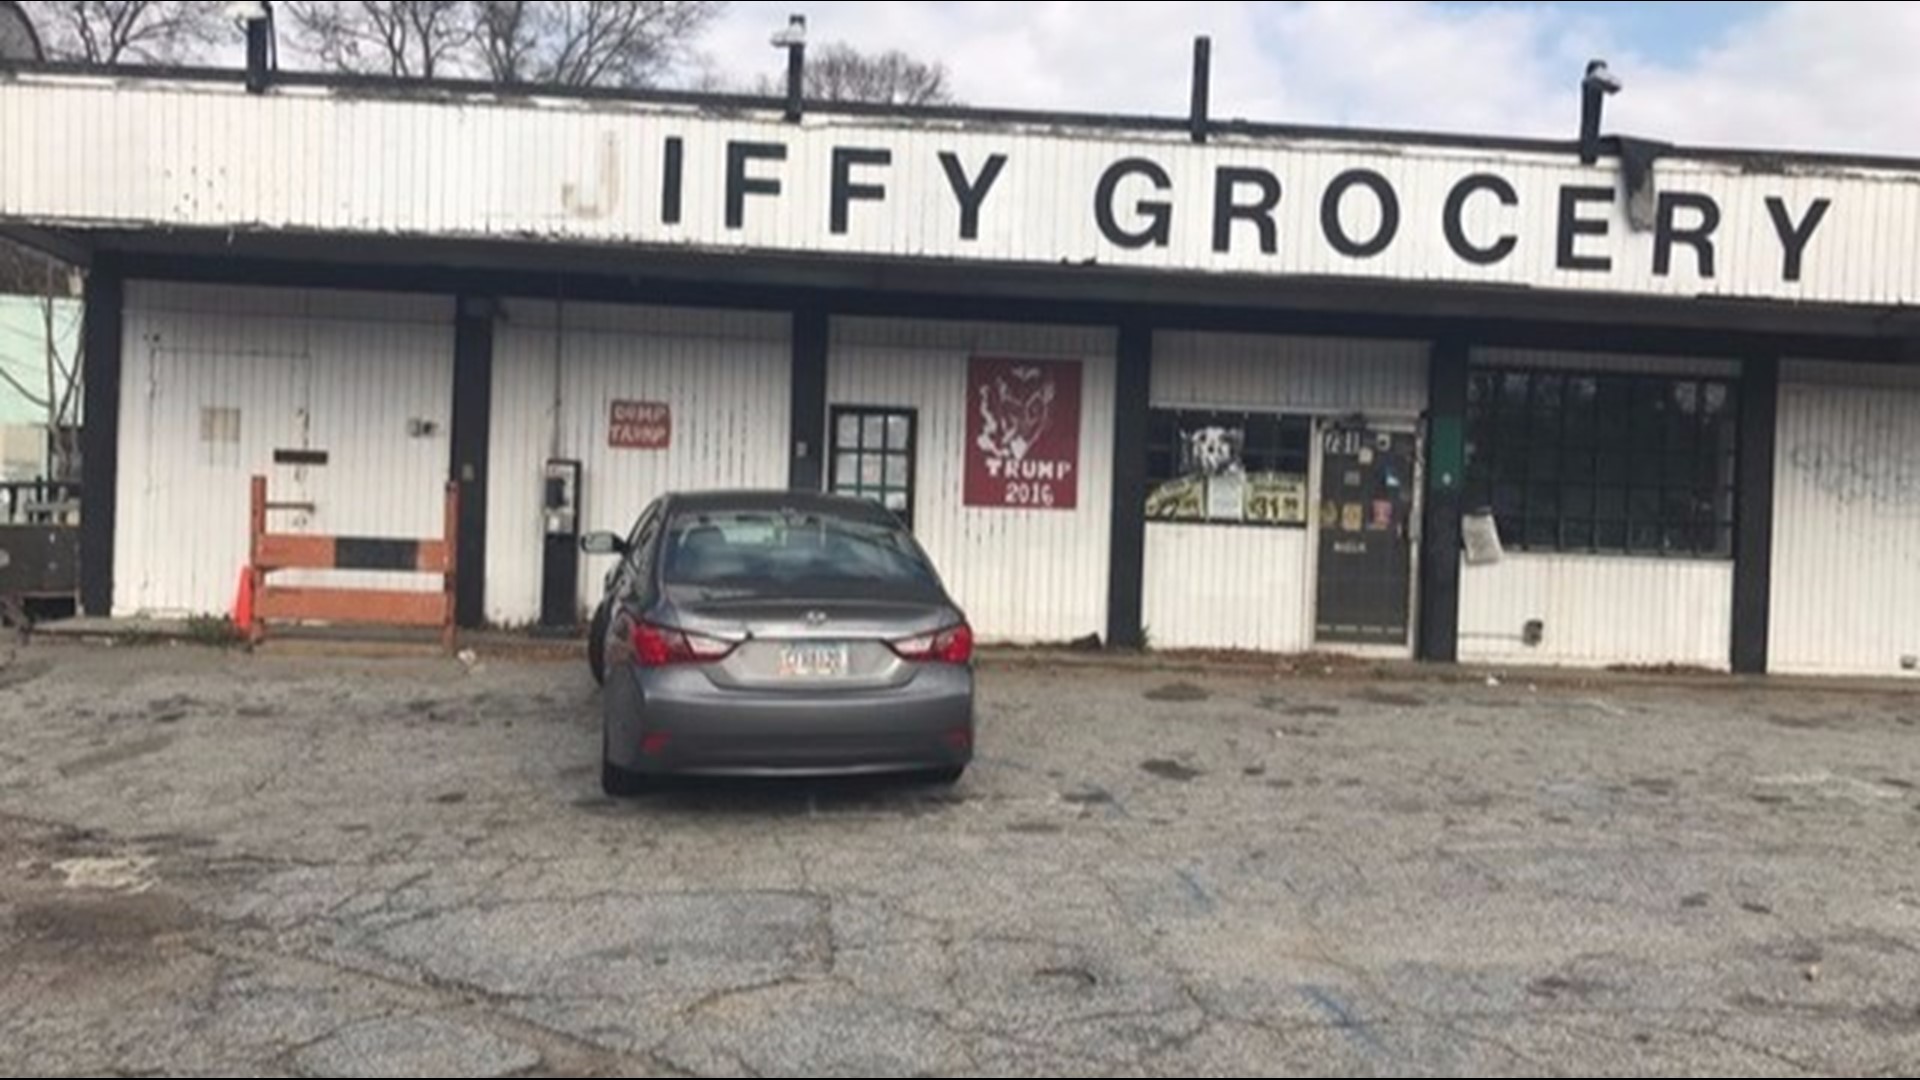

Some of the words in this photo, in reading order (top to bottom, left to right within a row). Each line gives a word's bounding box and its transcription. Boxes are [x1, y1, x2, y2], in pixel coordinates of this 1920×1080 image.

[1093, 157, 1832, 283] GROCERY
[985, 457, 1072, 481] TRUMP
[1005, 482, 1054, 507] 2016
